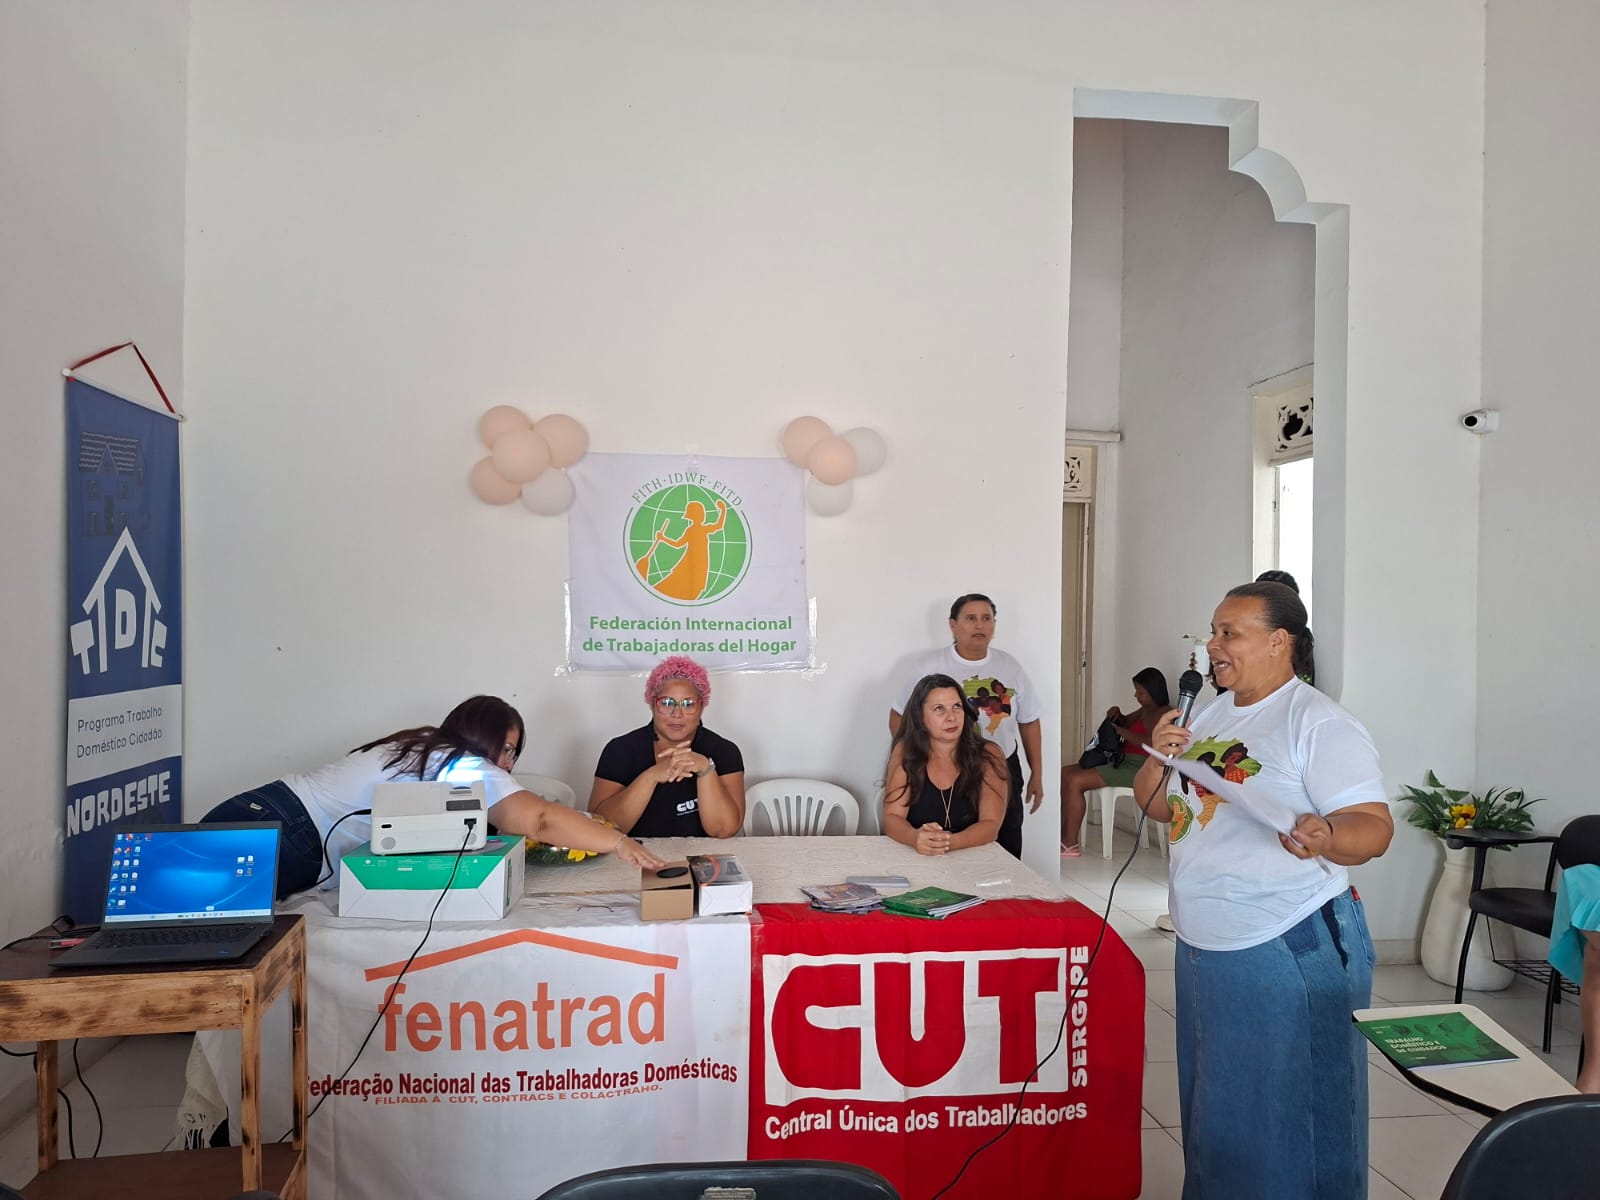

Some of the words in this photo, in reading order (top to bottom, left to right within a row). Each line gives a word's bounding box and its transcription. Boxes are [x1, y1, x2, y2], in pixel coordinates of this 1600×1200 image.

[631, 478, 663, 503] FITH
[668, 472, 707, 484] IDWF
[712, 480, 743, 507] FITD
[590, 615, 681, 631] Federación
[686, 615, 792, 631] Internacional
[582, 638, 603, 651] de
[606, 638, 714, 655] Trabajadoras
[718, 638, 743, 652] del
[748, 639, 796, 655] Hogar
[77, 713, 125, 733] Programa
[127, 706, 162, 721] Trabalho
[77, 737, 127, 758] Doméstico
[128, 728, 162, 746] Cidadão
[67, 771, 170, 837] NORDESTE
[378, 972, 665, 1052] fenatrad
[770, 956, 1060, 1091] CUT
[1070, 945, 1089, 1088] SERGIPE
[308, 1073, 393, 1101] ederação
[399, 1072, 475, 1094] Nacional
[481, 1072, 511, 1092] das
[517, 1067, 638, 1092] Trabalhadoras
[645, 1057, 738, 1083] Domésticas
[375, 1096, 428, 1105] FILIADA
[483, 1093, 556, 1103] CONTRACS
[559, 1092, 566, 1100] E
[765, 1109, 832, 1140] Central
[839, 1104, 899, 1134] Única
[904, 1110, 939, 1132] dos
[945, 1101, 1088, 1128] Trabalhadores
